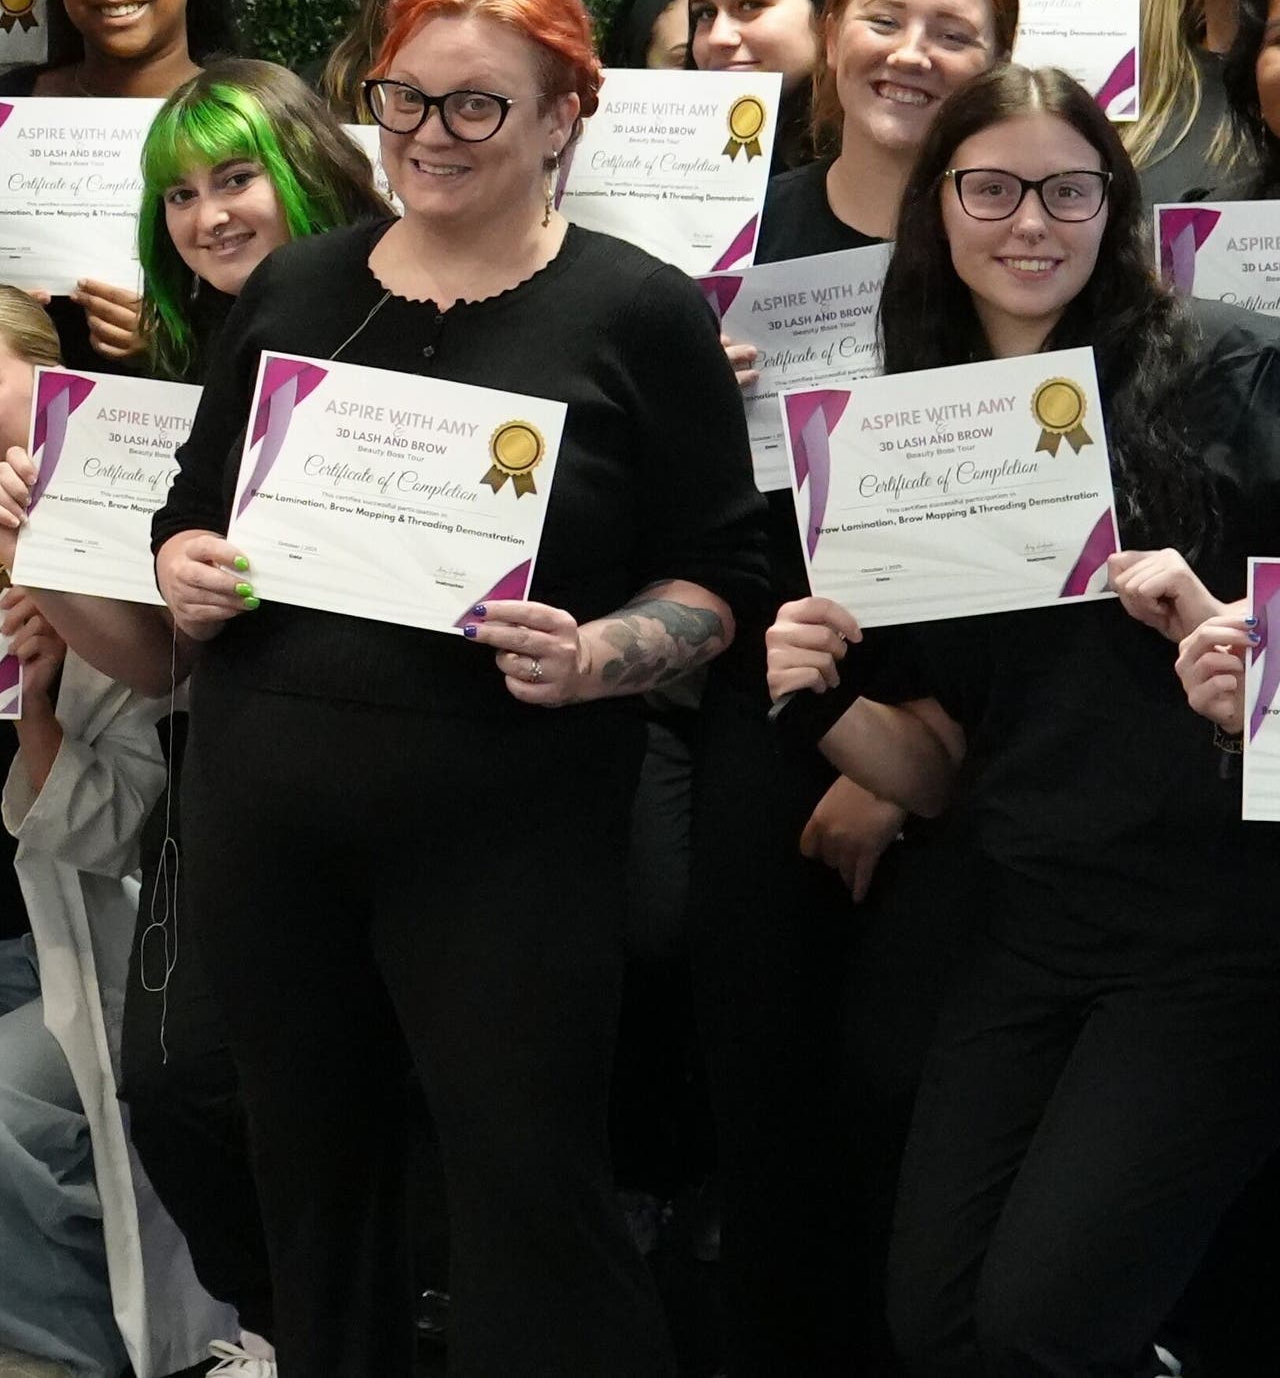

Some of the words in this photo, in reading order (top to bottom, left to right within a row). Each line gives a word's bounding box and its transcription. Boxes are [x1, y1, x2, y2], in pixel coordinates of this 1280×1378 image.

[17, 128, 65, 140] ASPIRE
[71, 128, 105, 140] WITH
[112, 128, 142, 140] AMY
[92, 150, 120, 158] BROW
[752, 292, 807, 313] ASPIRE
[813, 284, 853, 304] WITH
[858, 279, 883, 295] AM
[768, 321, 782, 331] 3D
[784, 317, 812, 328] LASH
[815, 311, 837, 323] AND
[840, 306, 874, 318] BROW
[324, 400, 386, 423] ASPIRE
[389, 409, 434, 432] WITH
[436, 418, 480, 438] AMY
[860, 409, 921, 432] ASPIRE
[924, 402, 972, 423] WITH
[977, 395, 1017, 416] AMY
[335, 427, 351, 439] 3D
[352, 430, 382, 445] LASH
[383, 436, 409, 449] AND
[411, 441, 448, 456] BROW
[357, 445, 385, 458] Beauty
[386, 450, 405, 460] Boss
[407, 454, 425, 463] Tour
[879, 441, 895, 452] 3D
[896, 436, 927, 450] LASH
[929, 432, 955, 445] AND
[957, 426, 993, 441] BROW
[905, 450, 934, 460] Beauty
[957, 444, 976, 452] Tour
[303, 453, 374, 486] Certificate
[377, 471, 395, 495] of
[396, 470, 478, 502] Completion
[858, 471, 931, 500] Certificate
[936, 467, 951, 494] of
[956, 458, 1038, 485] Completion
[275, 491, 328, 510] Lamination,
[329, 501, 354, 513] Brow
[355, 506, 396, 524] Mapping
[397, 514, 405, 523] &
[407, 515, 454, 535] Threading
[455, 524, 525, 545] Demonstration
[841, 519, 897, 532] Lamination,
[898, 515, 924, 525] Brow
[925, 510, 967, 520] Mapping
[969, 505, 977, 515] &
[978, 501, 1027, 514] Threading
[1028, 491, 1099, 507] Demonstration
